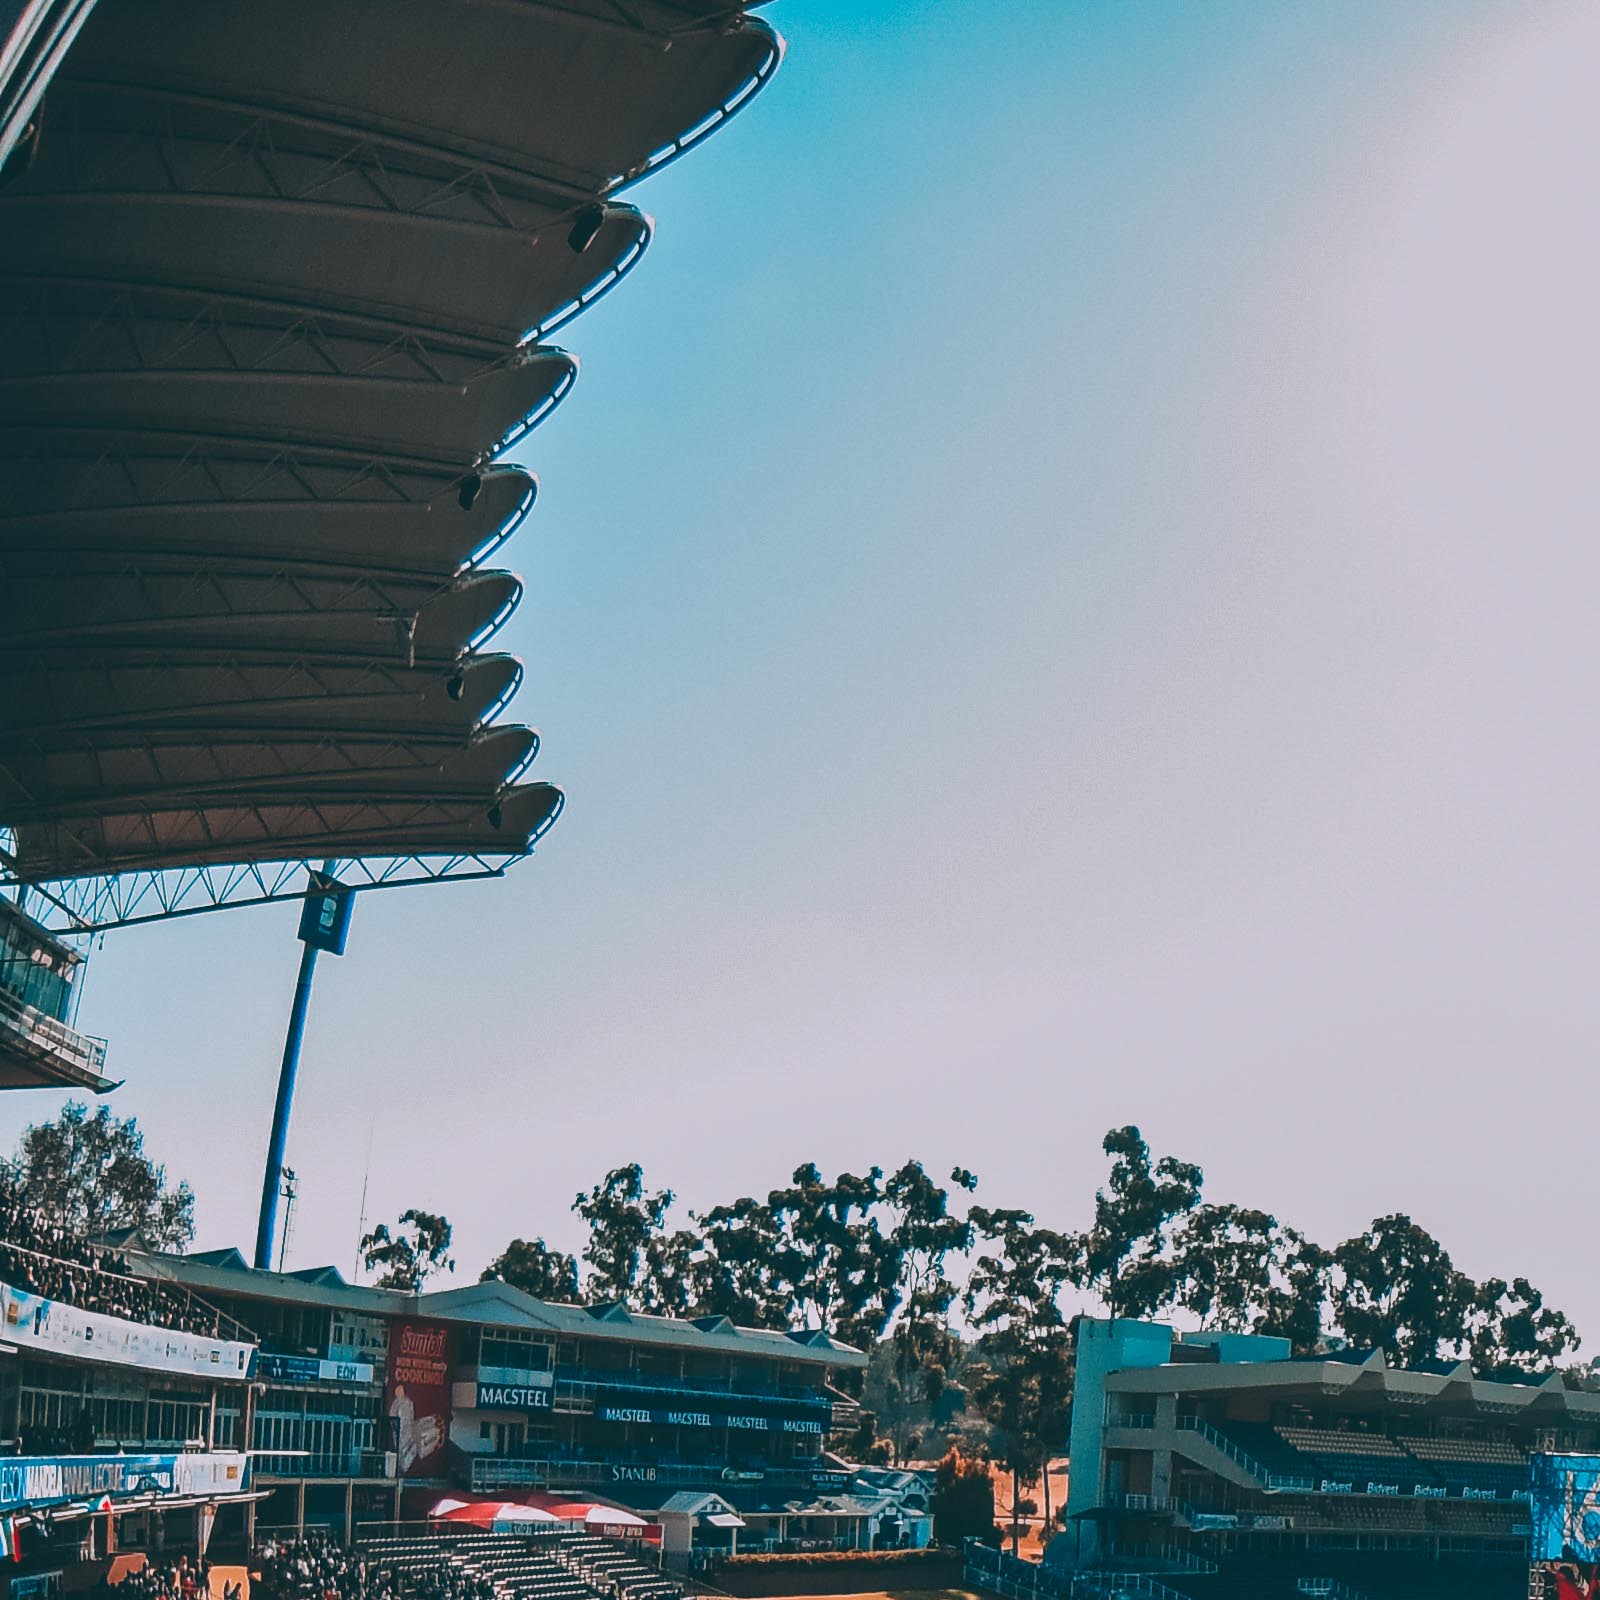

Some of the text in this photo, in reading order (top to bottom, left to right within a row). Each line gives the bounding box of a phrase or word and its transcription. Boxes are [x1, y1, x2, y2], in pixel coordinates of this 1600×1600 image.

[480, 1387, 549, 1407] MACSTEEL
[606, 1408, 652, 1423] MACSTEEL
[668, 1412, 711, 1426] MACSTEEL
[727, 1416, 768, 1430] MACSTEEL
[783, 1420, 822, 1434] MACSTEEL
[1321, 1480, 1352, 1493] Bidvest
[1367, 1482, 1399, 1496] Bidvest
[1414, 1484, 1447, 1498] Bidvest
[1462, 1486, 1496, 1500] Bidvest
[603, 1524, 644, 1538] family area
